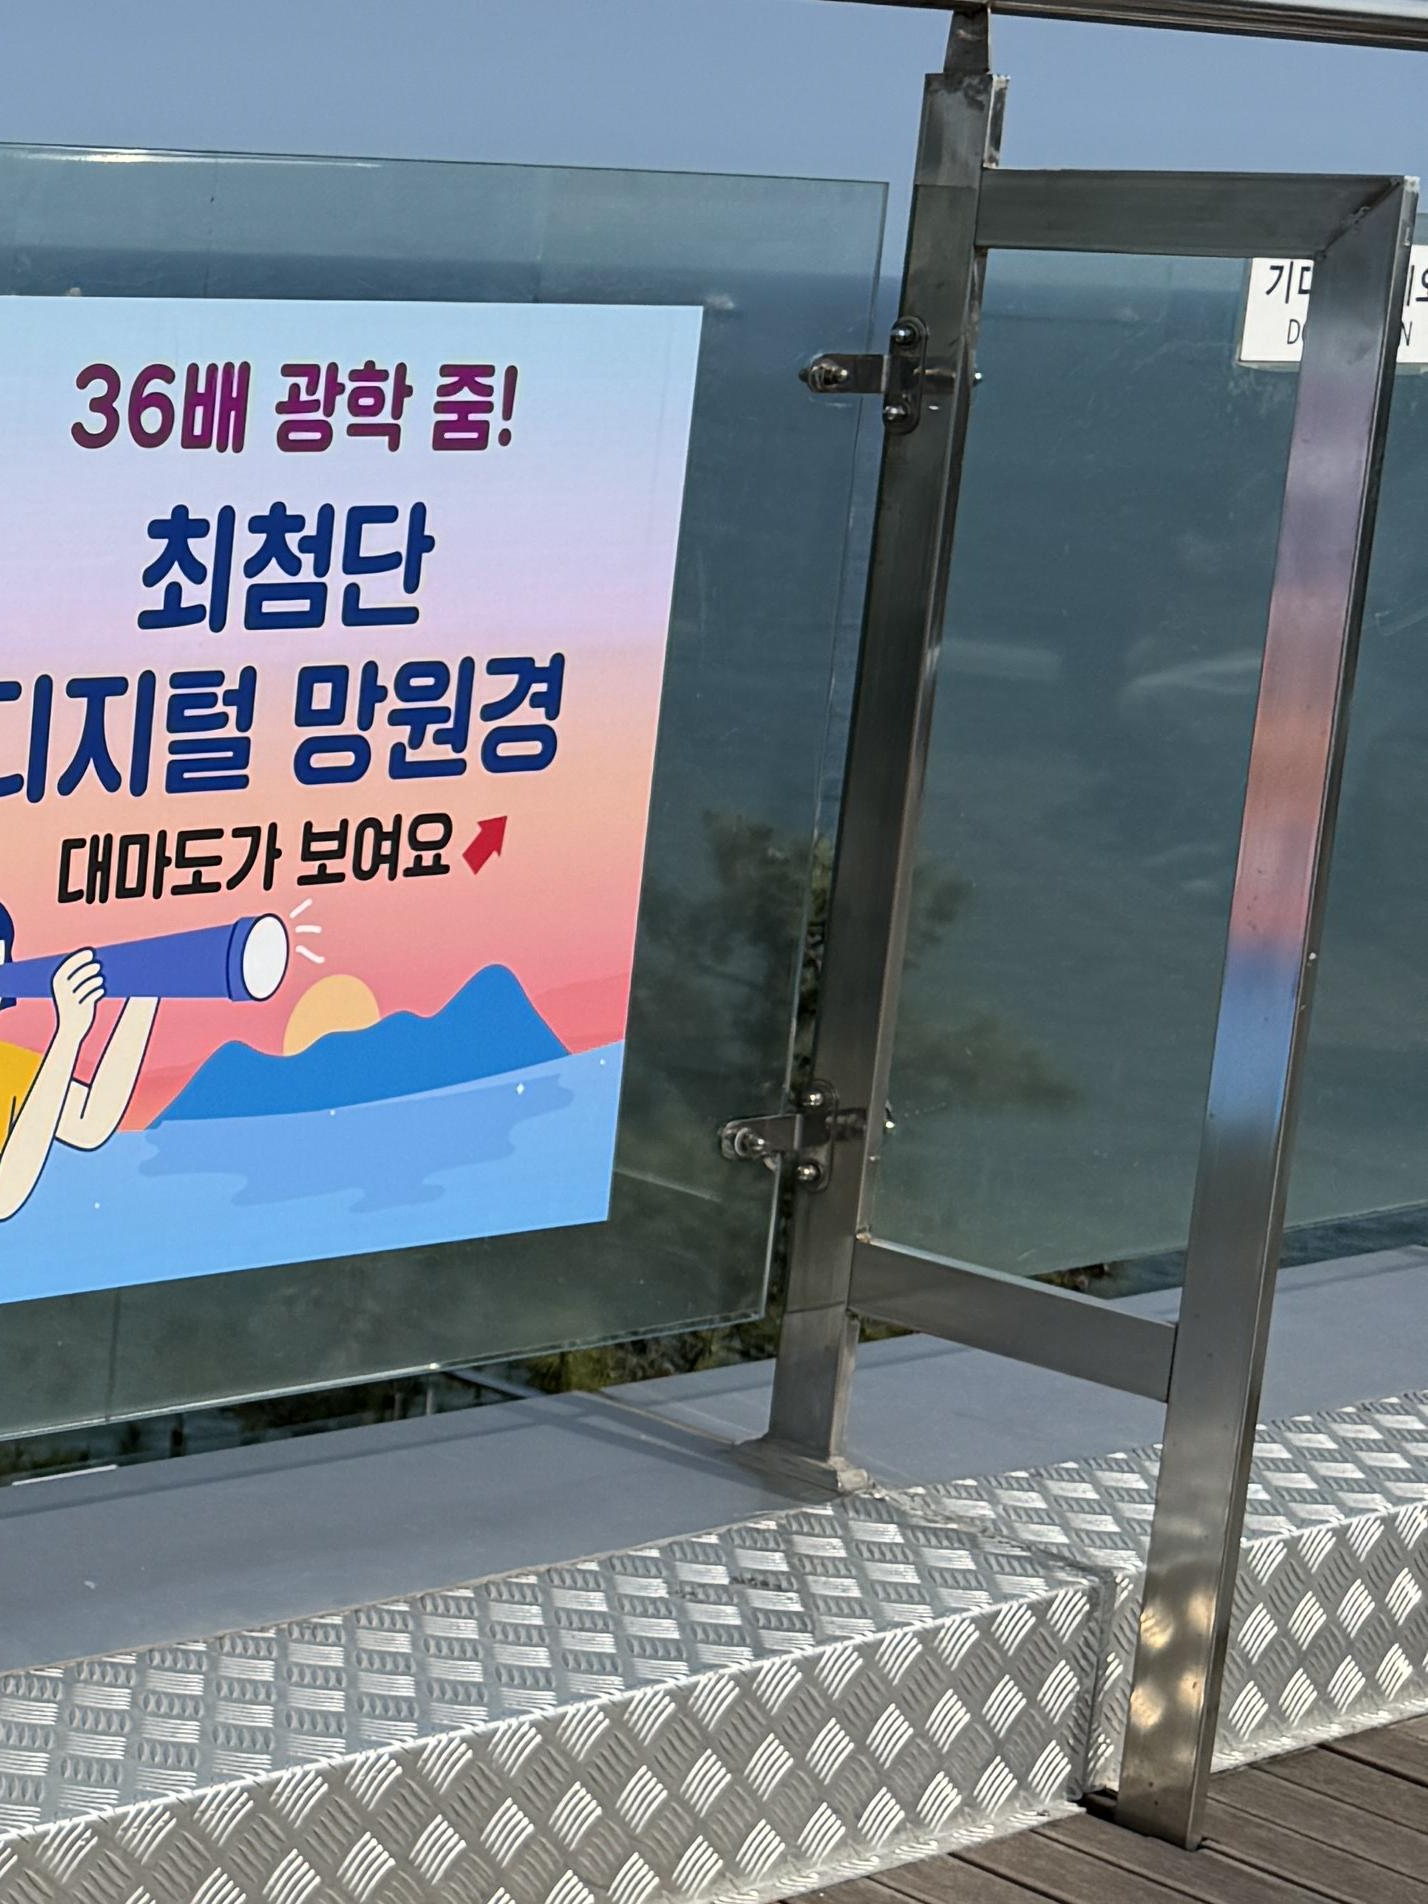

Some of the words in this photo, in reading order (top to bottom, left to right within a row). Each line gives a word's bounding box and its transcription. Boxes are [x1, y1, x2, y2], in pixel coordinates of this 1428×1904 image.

[71, 360, 252, 455] 36배
[274, 359, 414, 454] 광학
[432, 362, 519, 453] 줌!
[136, 500, 437, 635] 최첨단
[291, 651, 566, 788] 망원경
[56, 821, 283, 906] 대마도가
[295, 810, 454, 890] 보여요
